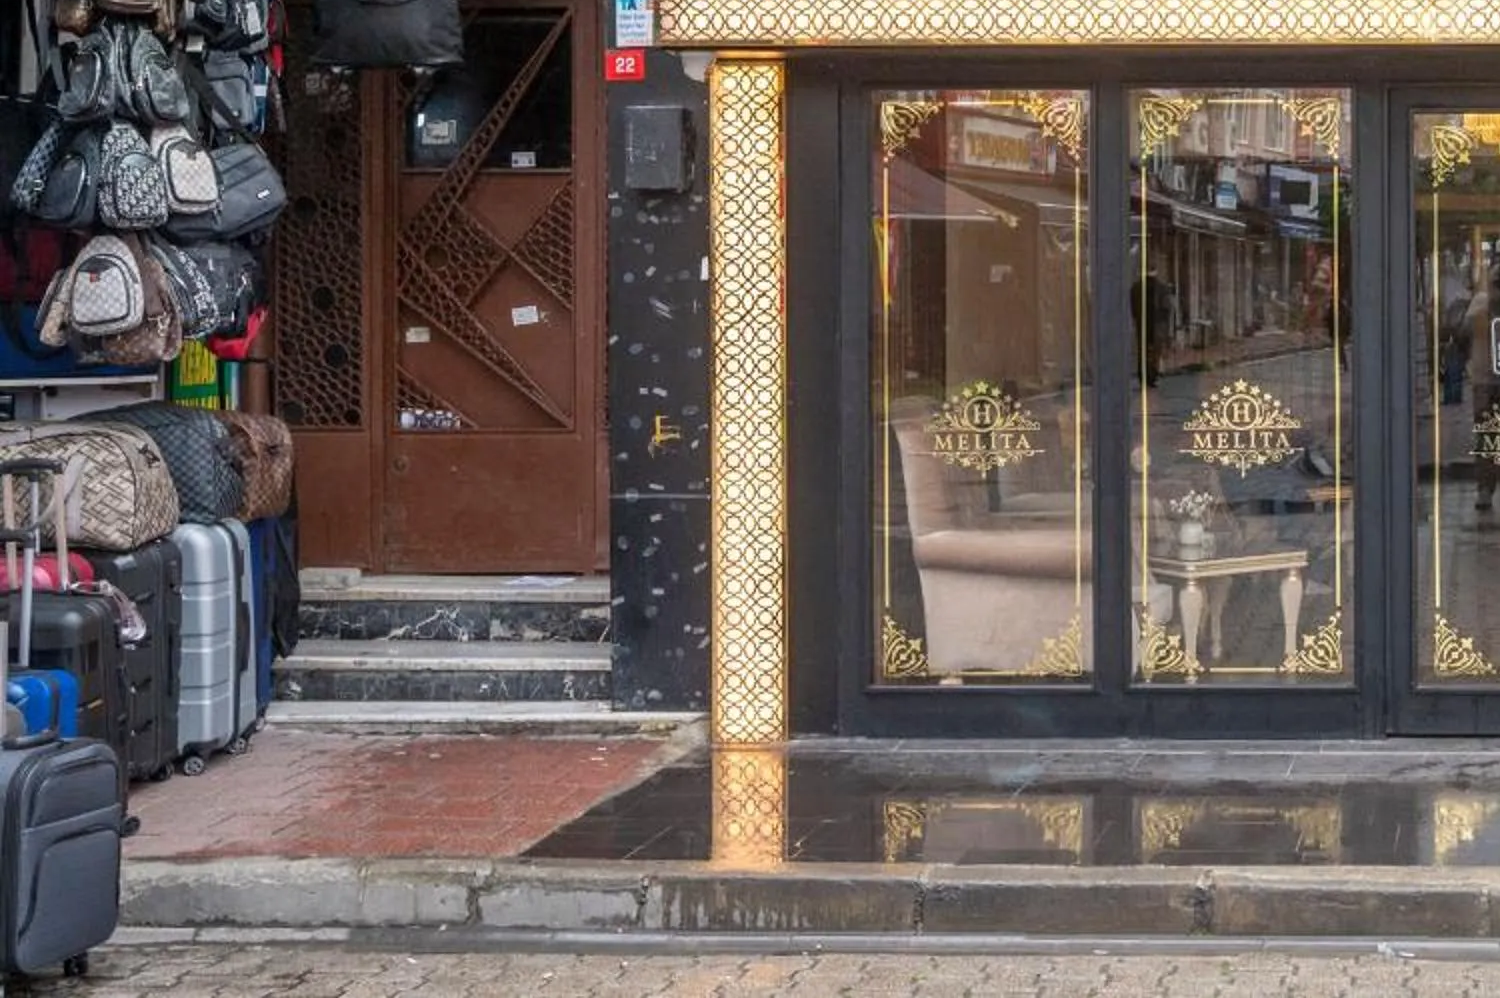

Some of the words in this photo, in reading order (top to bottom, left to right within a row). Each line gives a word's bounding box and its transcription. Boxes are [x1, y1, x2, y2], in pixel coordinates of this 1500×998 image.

[615, 57, 635, 74] 22
[973, 404, 991, 424] H
[1231, 402, 1251, 423] H
